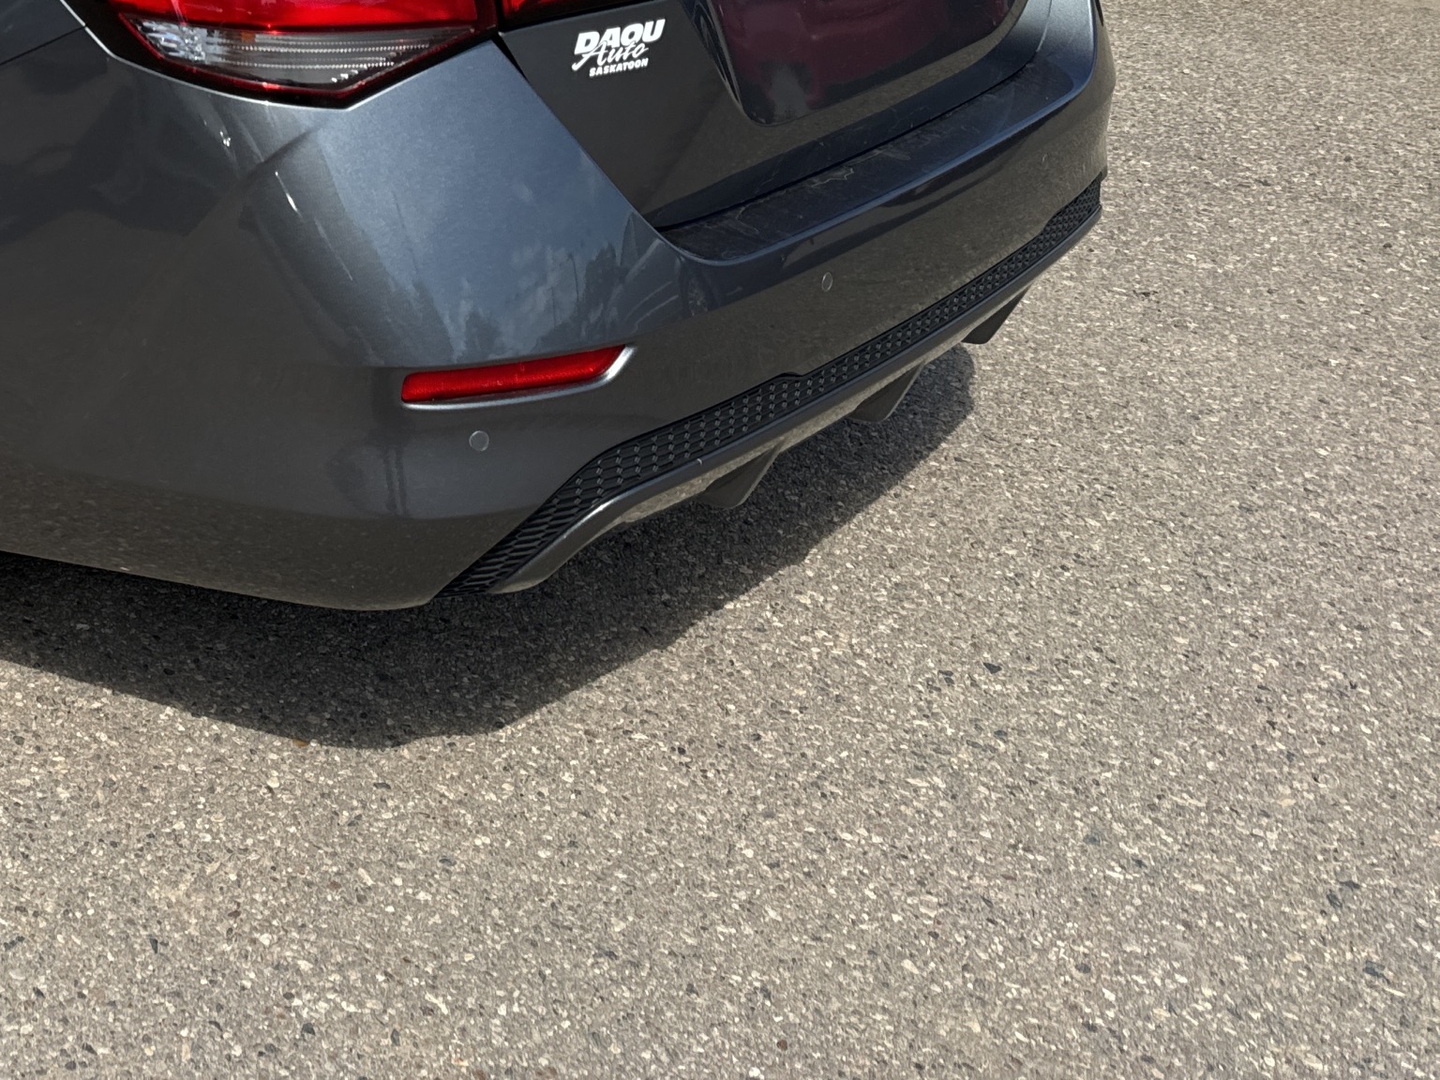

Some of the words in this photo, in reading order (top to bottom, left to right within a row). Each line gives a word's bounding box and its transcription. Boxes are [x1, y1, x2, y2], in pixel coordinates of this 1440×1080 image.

[573, 18, 666, 55] DAOU
[571, 40, 649, 71] Auto
[588, 57, 649, 77] SASKATOON
